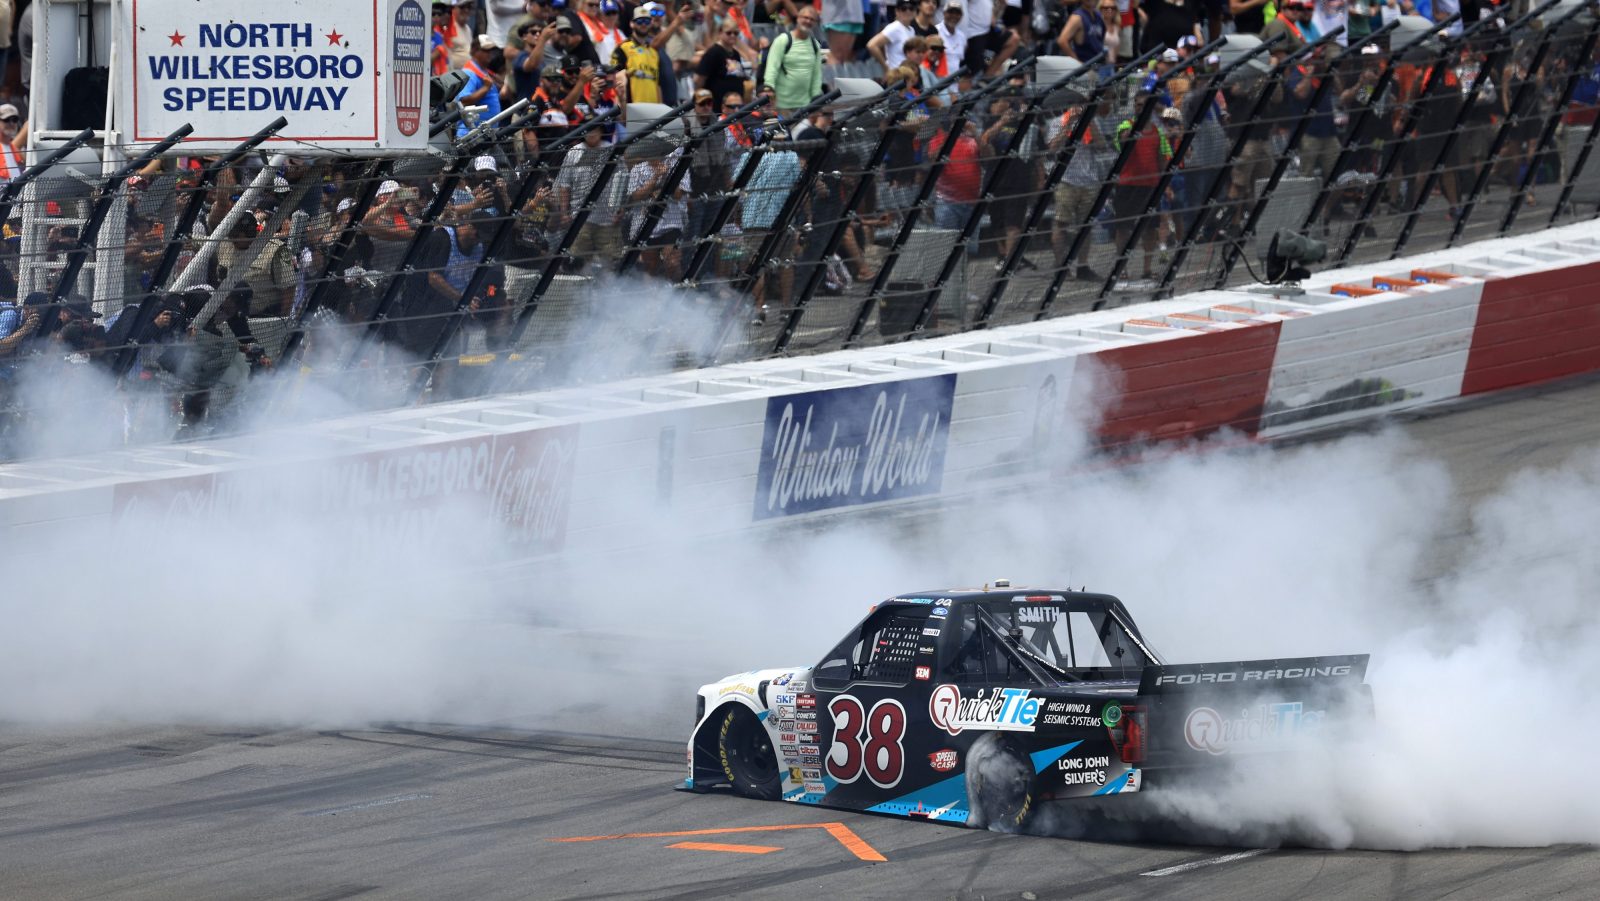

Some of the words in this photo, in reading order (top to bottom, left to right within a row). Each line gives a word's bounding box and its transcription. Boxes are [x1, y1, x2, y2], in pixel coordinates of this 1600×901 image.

[198, 22, 313, 49] NORTH
[148, 54, 364, 80] WILKESBORO
[162, 86, 349, 112] SPEEDWAY
[768, 402, 861, 511] Window
[860, 390, 940, 497] World
[1018, 606, 1061, 623] SMITH
[915, 667, 930, 679] SEM
[1156, 671, 1238, 686] FORD
[1242, 665, 1352, 681] RACING
[776, 695, 796, 704] SKF
[1047, 702, 1066, 713] HIGH
[1065, 703, 1085, 713] WIND
[1084, 704, 1091, 714] &
[929, 684, 1040, 736] QuickTie
[1043, 714, 1070, 725] SEISMIC
[1070, 716, 1101, 727] SYSTEMS
[826, 694, 907, 789] 38
[935, 751, 958, 762] SPEEDY
[1058, 758, 1083, 770] LONG
[1084, 756, 1109, 769] JOHN
[1064, 769, 1107, 786] SILVER'S
